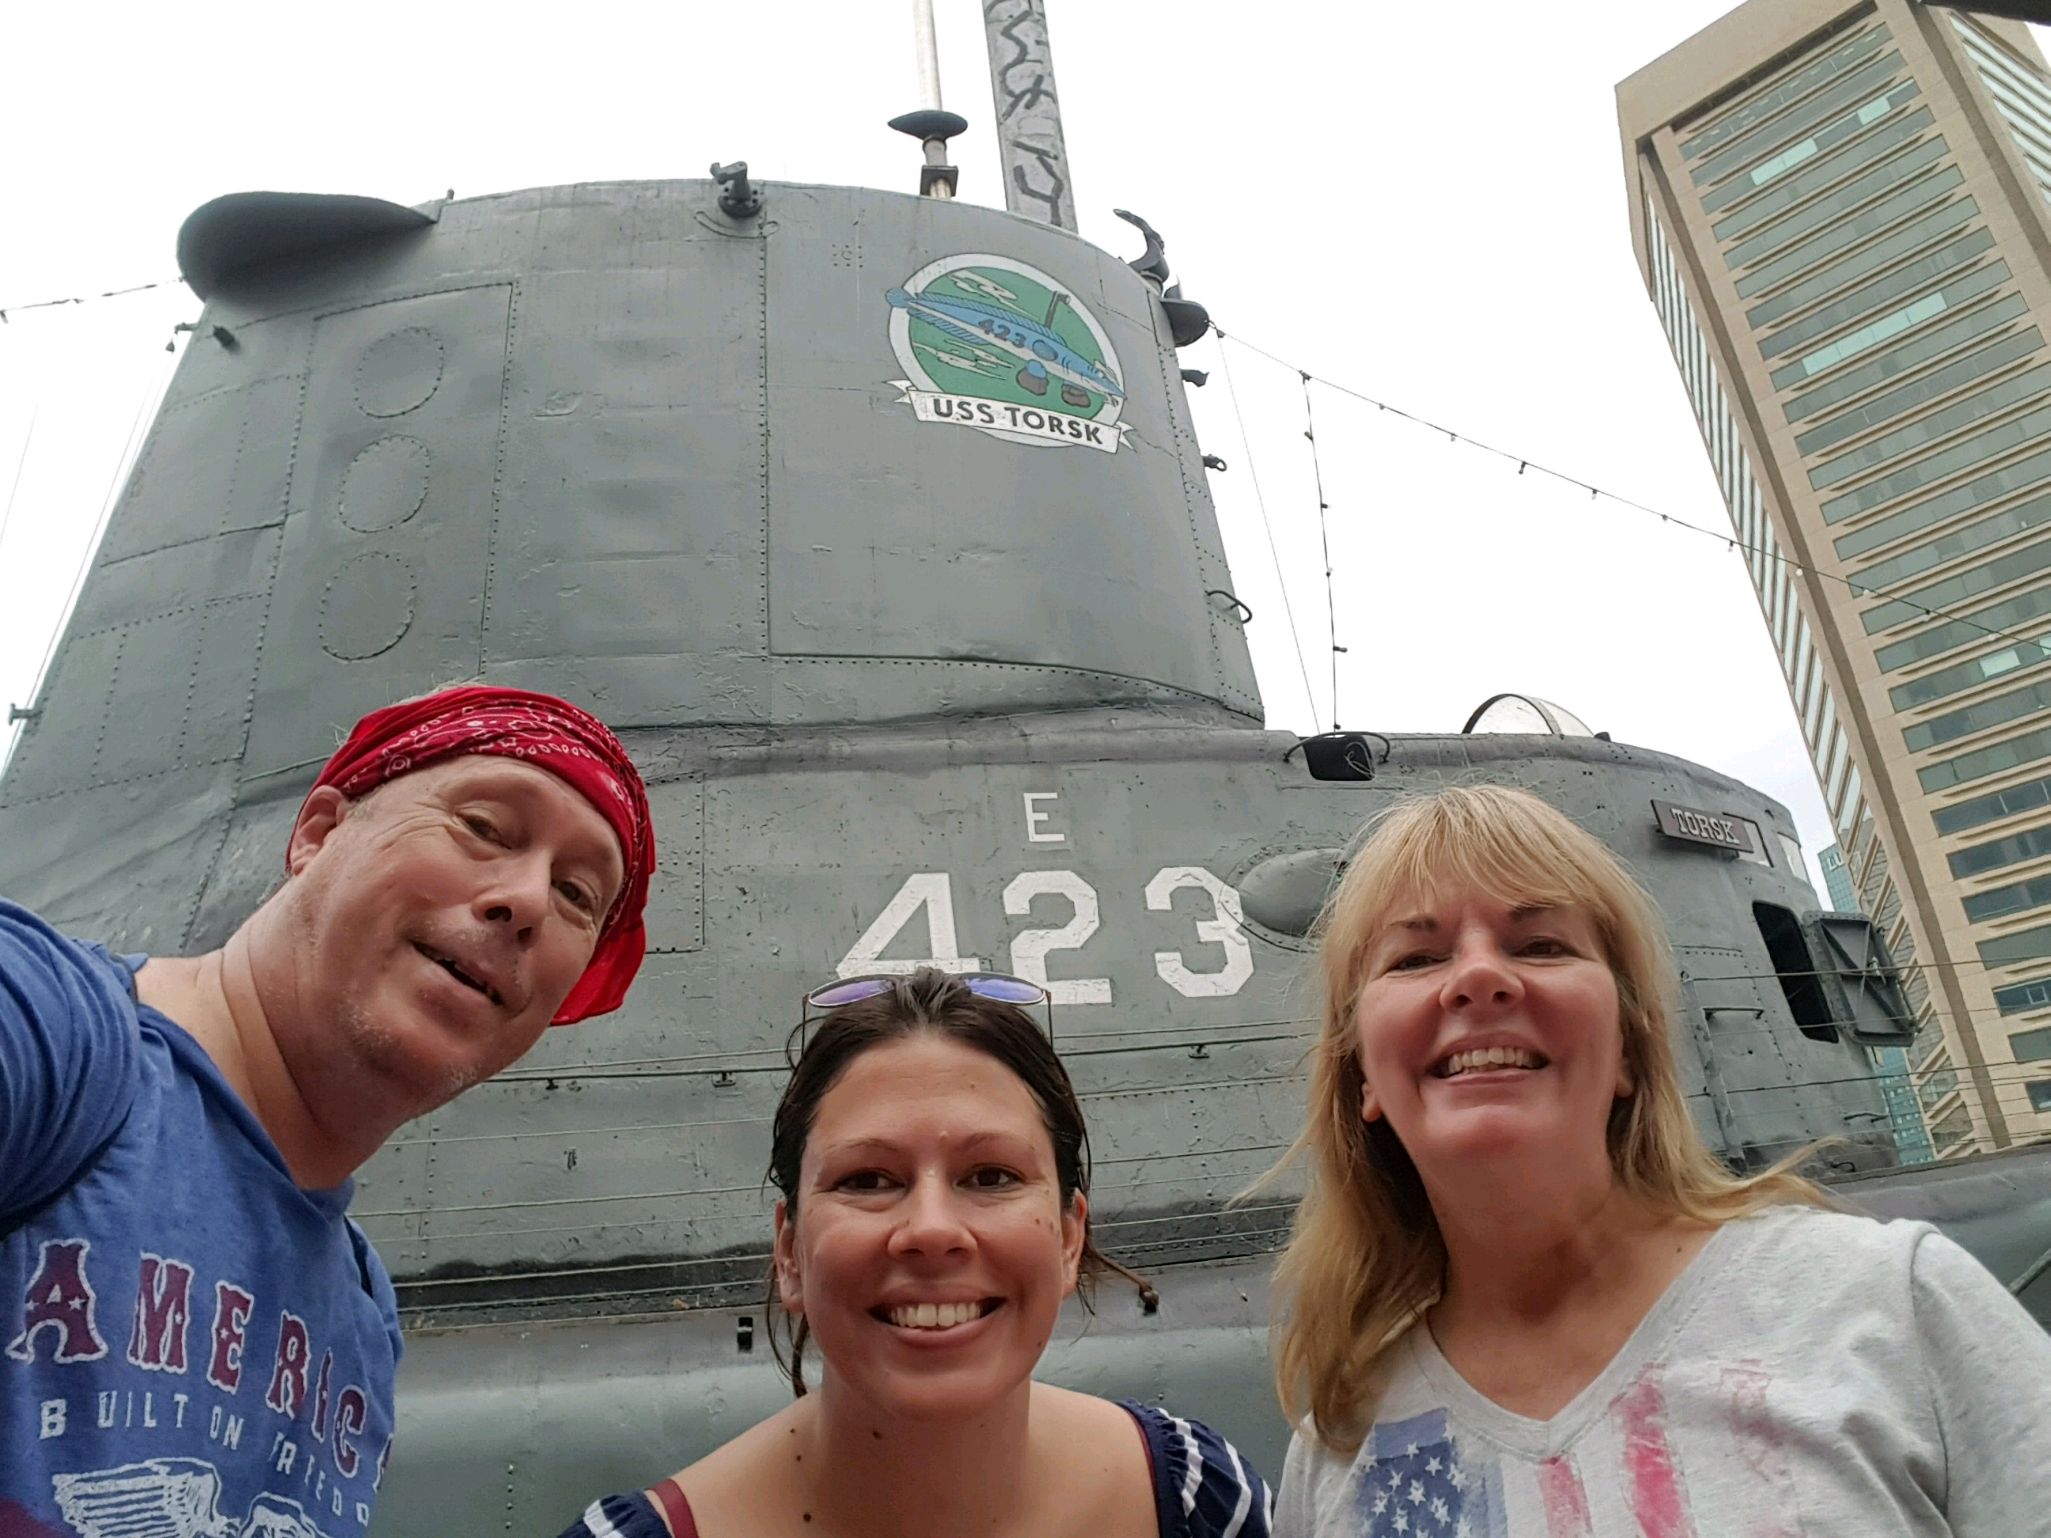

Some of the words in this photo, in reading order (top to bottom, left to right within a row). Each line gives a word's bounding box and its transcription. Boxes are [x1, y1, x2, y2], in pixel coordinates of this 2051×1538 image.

[978, 319, 1026, 348] 423
[933, 398, 995, 424] USS
[1004, 407, 1103, 445] TORSK
[1023, 792, 1065, 842] E
[1671, 808, 1740, 844] TORSK
[836, 866, 1256, 1005] 423
[5, 1237, 394, 1493] AMERIC
[39, 1391, 189, 1440] BUILT
[210, 1405, 245, 1450] ON
